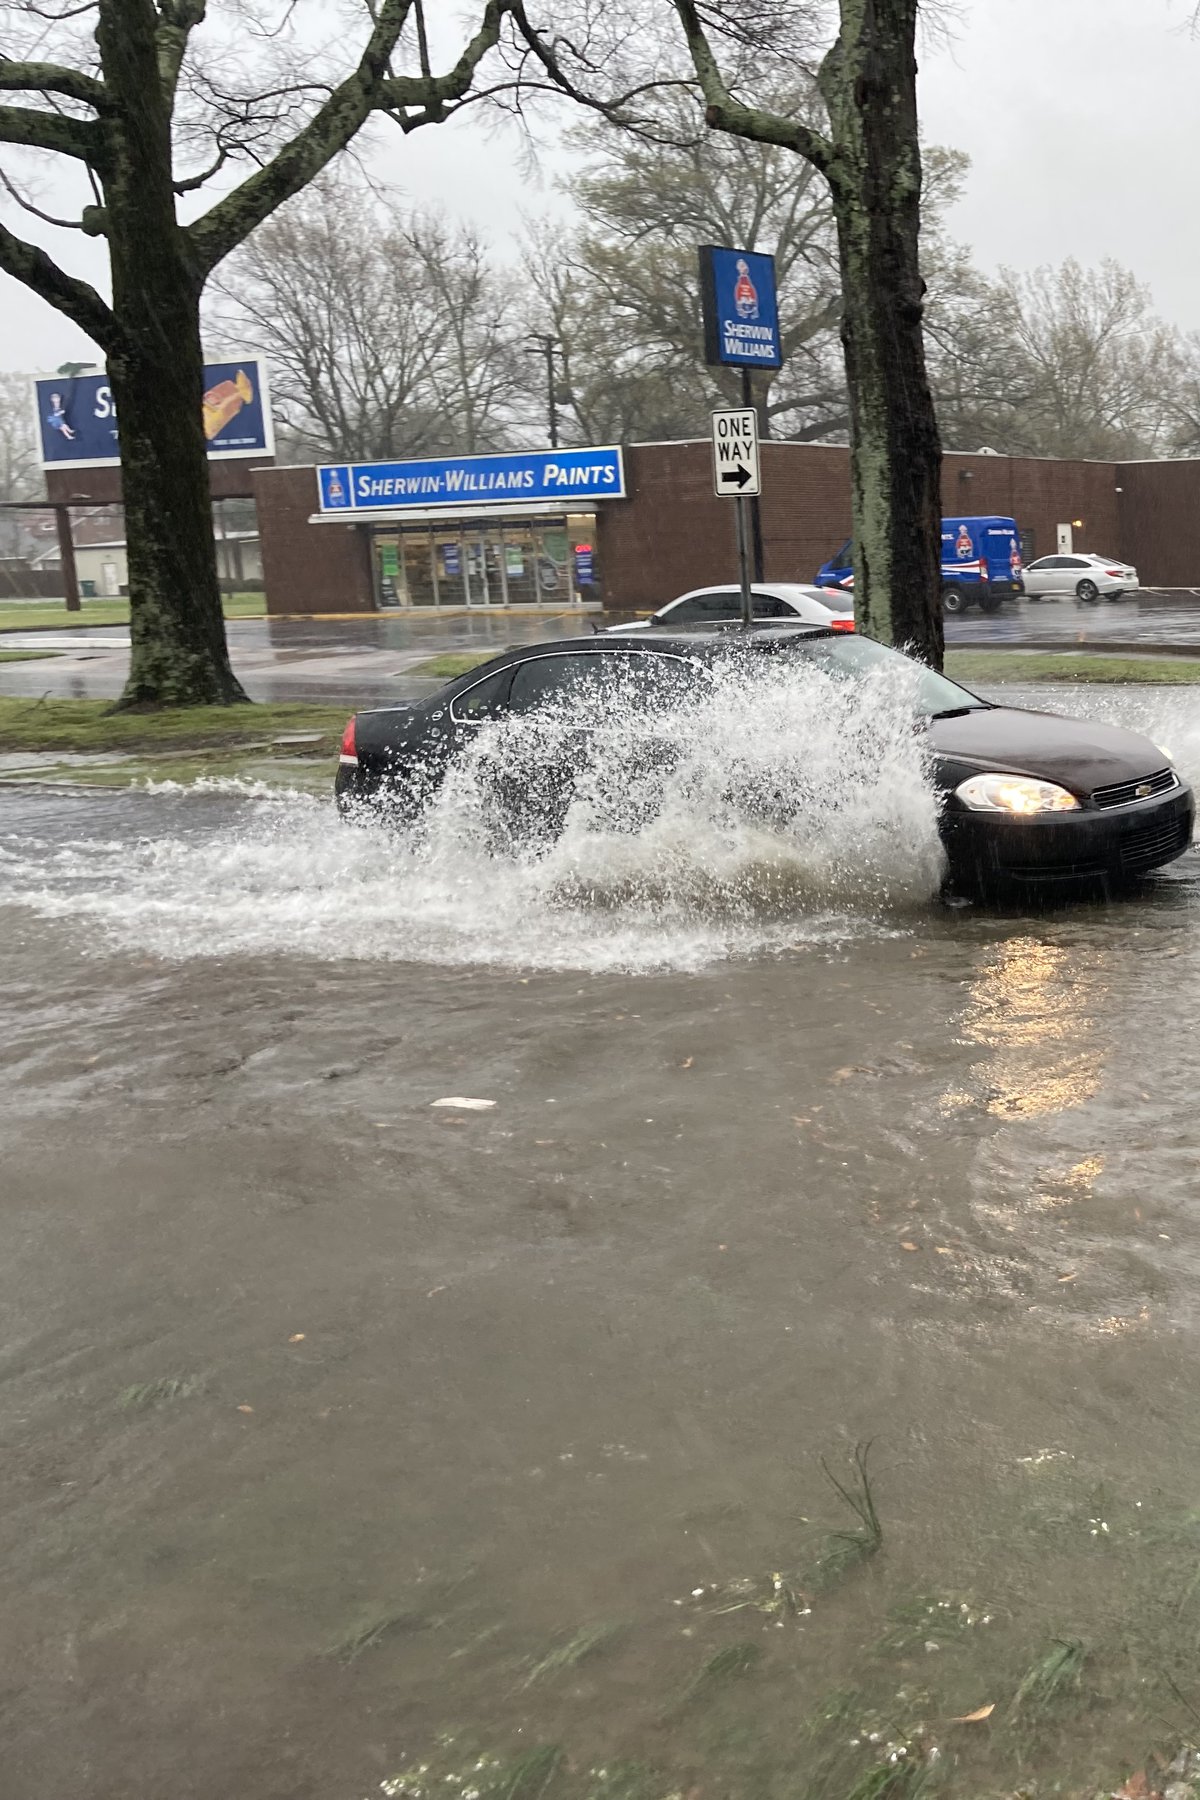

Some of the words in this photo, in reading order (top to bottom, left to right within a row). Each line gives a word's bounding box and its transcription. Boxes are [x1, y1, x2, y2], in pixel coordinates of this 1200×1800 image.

[724, 320, 773, 340] SHERWIN
[724, 338, 775, 358] WILLIAMS
[718, 417, 751, 437] ONE
[718, 441, 752, 461] WAY
[357, 470, 534, 497] SHERWIN-WILLIAMS
[542, 464, 615, 486] PAINTS
